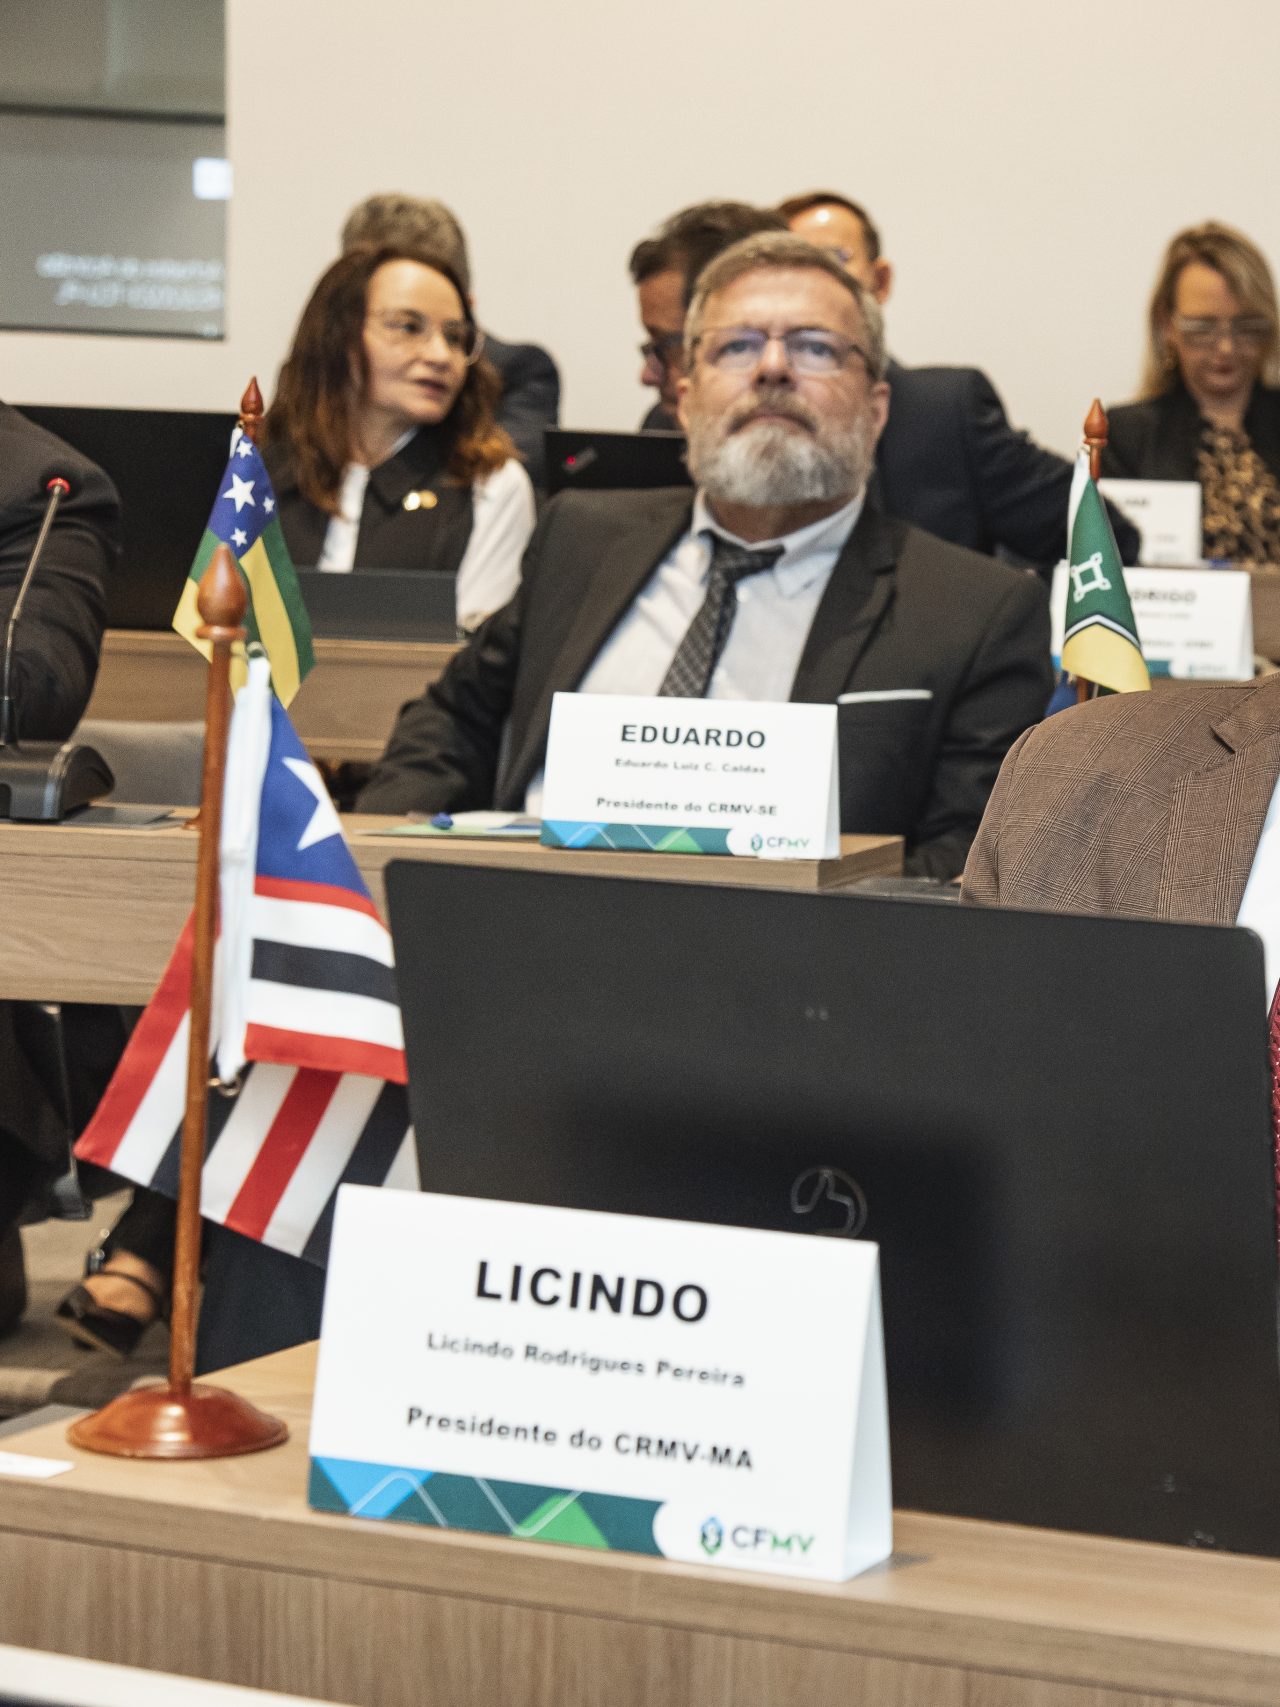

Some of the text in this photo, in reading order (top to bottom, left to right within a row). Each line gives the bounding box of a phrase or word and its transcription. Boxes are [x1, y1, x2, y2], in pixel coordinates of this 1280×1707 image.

[620, 724, 766, 749] EDUARDO
[614, 757, 669, 770] Eduardo
[721, 763, 766, 774] Caldas
[596, 796, 777, 816] Presidente do CRMV-SE
[766, 836, 810, 849] CFMV
[475, 1260, 709, 1324] LICINDO
[426, 1332, 746, 1388] Licindo Rodrigues Pereira
[406, 1406, 754, 1470] Presidente do CRMV-MA
[731, 1524, 815, 1554] CFMV
